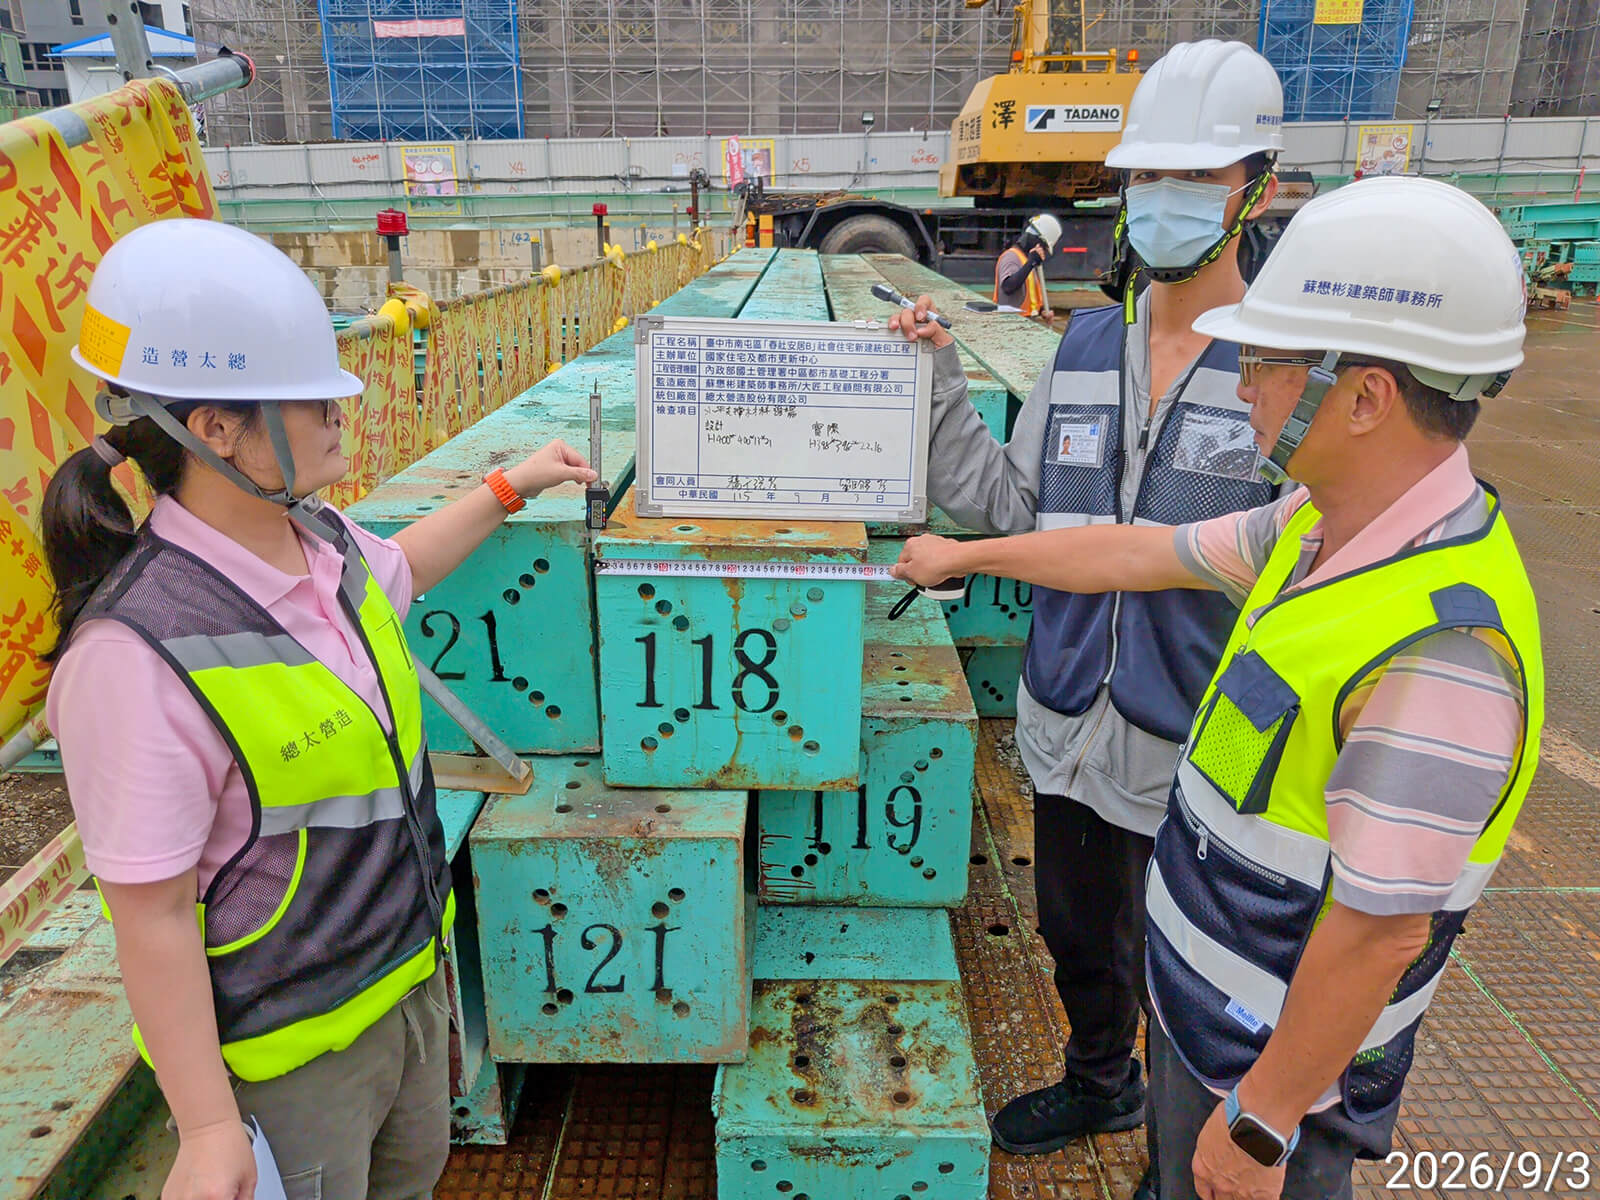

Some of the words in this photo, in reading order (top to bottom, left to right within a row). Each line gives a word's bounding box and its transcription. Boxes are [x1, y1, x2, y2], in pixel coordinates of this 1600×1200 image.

[992, 100, 1016, 129] 澤
[1064, 108, 1120, 119] TADANO
[511, 231, 530, 243] 142
[1302, 280, 1444, 309] 蘇懋彬建築師事務所
[655, 336, 697, 348] 工程名稱
[656, 348, 697, 360] 主辦單位
[705, 351, 818, 364] 國家住宅及都市更新中心
[655, 364, 697, 375] 工程管理機關
[705, 366, 889, 381] 內政部國土管理署中區都市基礎工程分署
[656, 377, 697, 388] 監造廠商
[705, 379, 903, 394] 蘇懋彬建築師事務所/大匠工程顧問有限公司
[655, 391, 697, 401] 統包廠商
[705, 392, 808, 404] 總太營造股份有限公司
[656, 405, 697, 416] 檢查項目
[655, 476, 696, 486] 會同人員
[678, 489, 719, 500] 中華民國
[733, 491, 753, 502] 115
[766, 492, 776, 501] 年
[820, 493, 830, 503] 月
[876, 495, 884, 503] 日
[634, 627, 780, 714] 118
[280, 709, 353, 763] 總太營造
[804, 783, 923, 852] 119
[531, 923, 682, 994] 121
